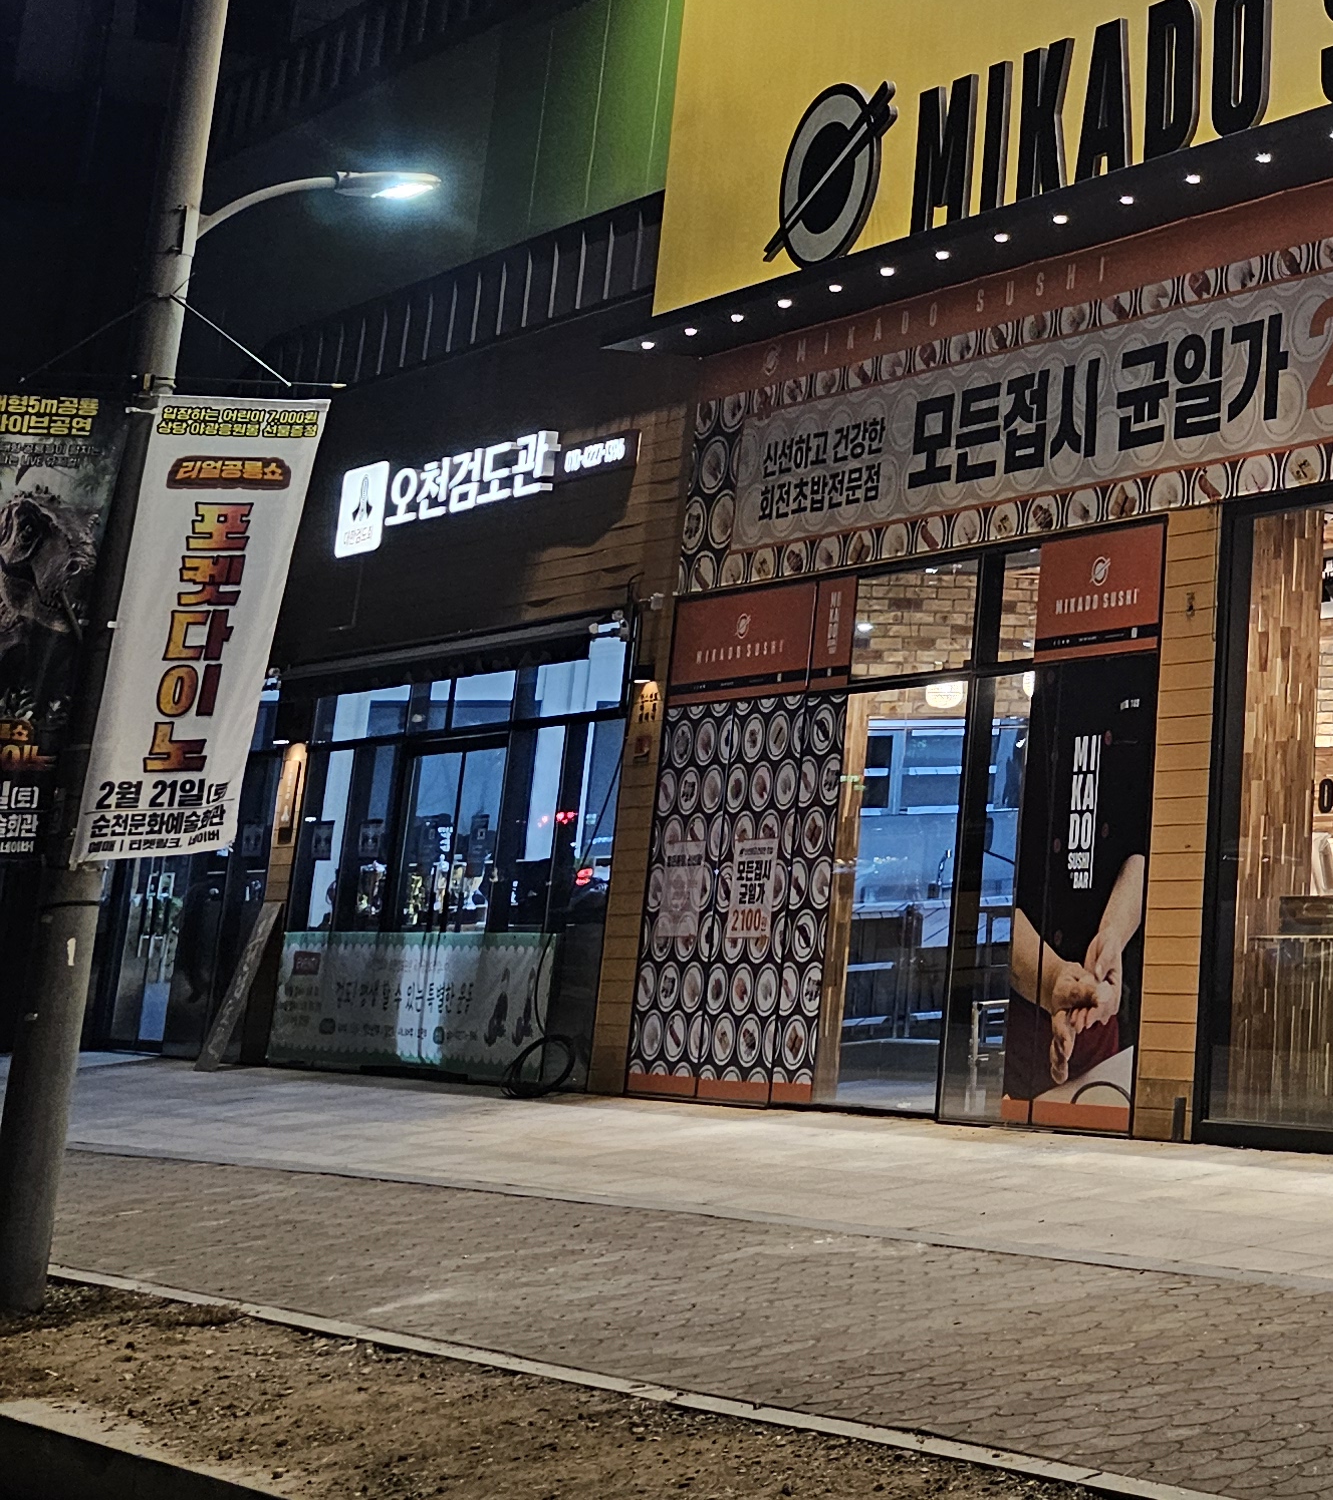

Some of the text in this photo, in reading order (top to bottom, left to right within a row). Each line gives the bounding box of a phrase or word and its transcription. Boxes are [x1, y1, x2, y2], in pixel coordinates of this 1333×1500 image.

[796, 256, 1105, 363] MIKADO SUSHI
[163, 405, 219, 421] 입장하는
[222, 409, 264, 423] 어린이
[907, 358, 1101, 489] 모든접시
[1116, 313, 1289, 452] 균일가
[763, 416, 886, 479] 신선하고 건강한
[176, 460, 283, 480] 리얼공룡쇼
[384, 431, 556, 526] 오천검도관
[758, 463, 881, 522] 회전초밥전문점
[1055, 588, 1139, 615] MIKADO SUSHI
[143, 501, 254, 773] 포켓다이노
[1073, 735, 1097, 772] MI
[96, 781, 143, 809] 2월
[1071, 774, 1094, 810] KA
[90, 804, 226, 838] 순천문화예술회관
[1068, 812, 1092, 849] DO
[737, 860, 772, 882] 모든접시
[1068, 852, 1090, 870] SUSHI
[738, 883, 766, 905] 균일가
